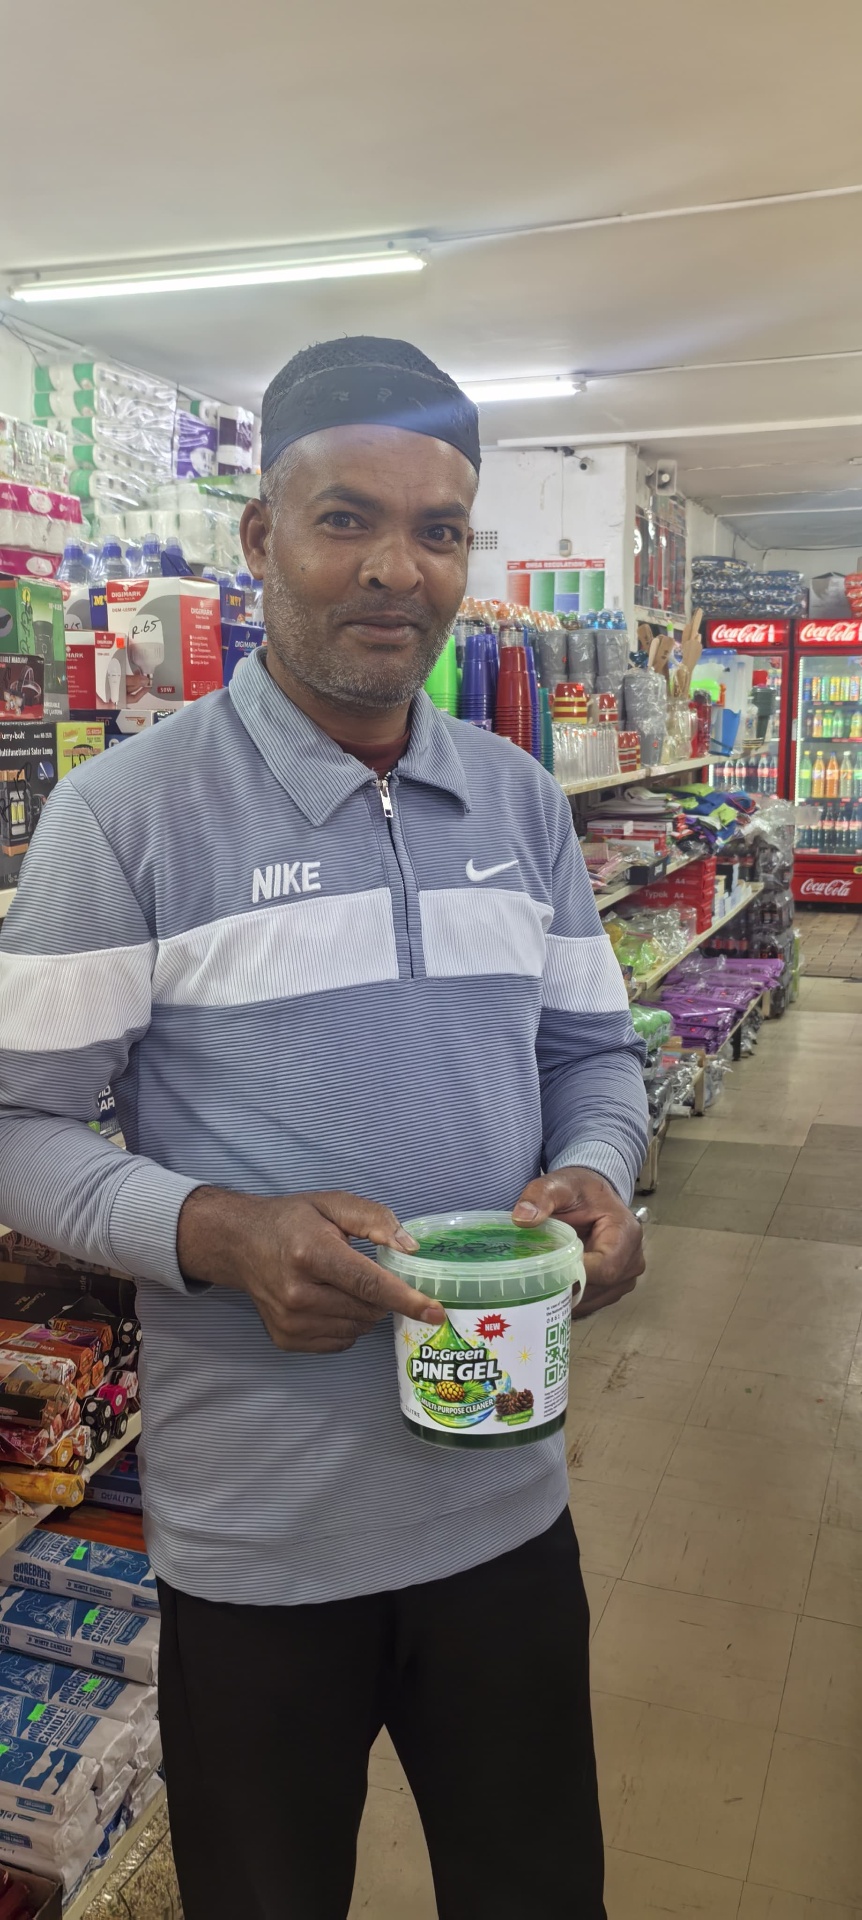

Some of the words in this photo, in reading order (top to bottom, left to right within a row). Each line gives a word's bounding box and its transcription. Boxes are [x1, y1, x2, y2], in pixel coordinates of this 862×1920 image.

[190, 607, 213, 616] DIGIMARK
[711, 623, 768, 643] Coca-Cola
[800, 622, 859, 642] Coca-Cola
[251, 861, 322, 903] NIKE
[800, 878, 853, 896] Coca-Cola
[674, 891, 685, 899] A4
[484, 1323, 501, 1331] NEW
[421, 1346, 485, 1360] Dr.Green
[412, 1360, 455, 1380] PINE
[457, 1361, 500, 1380] GEL
[421, 1397, 465, 1415] MULTI-PURPOSE
[465, 1398, 495, 1413] CLEANER
[101, 1491, 136, 1504] QUALITY
[13, 1562, 52, 1581] MOREBRITE
[13, 1574, 51, 1589] CANDLES
[89, 1586, 112, 1598] CANDLES
